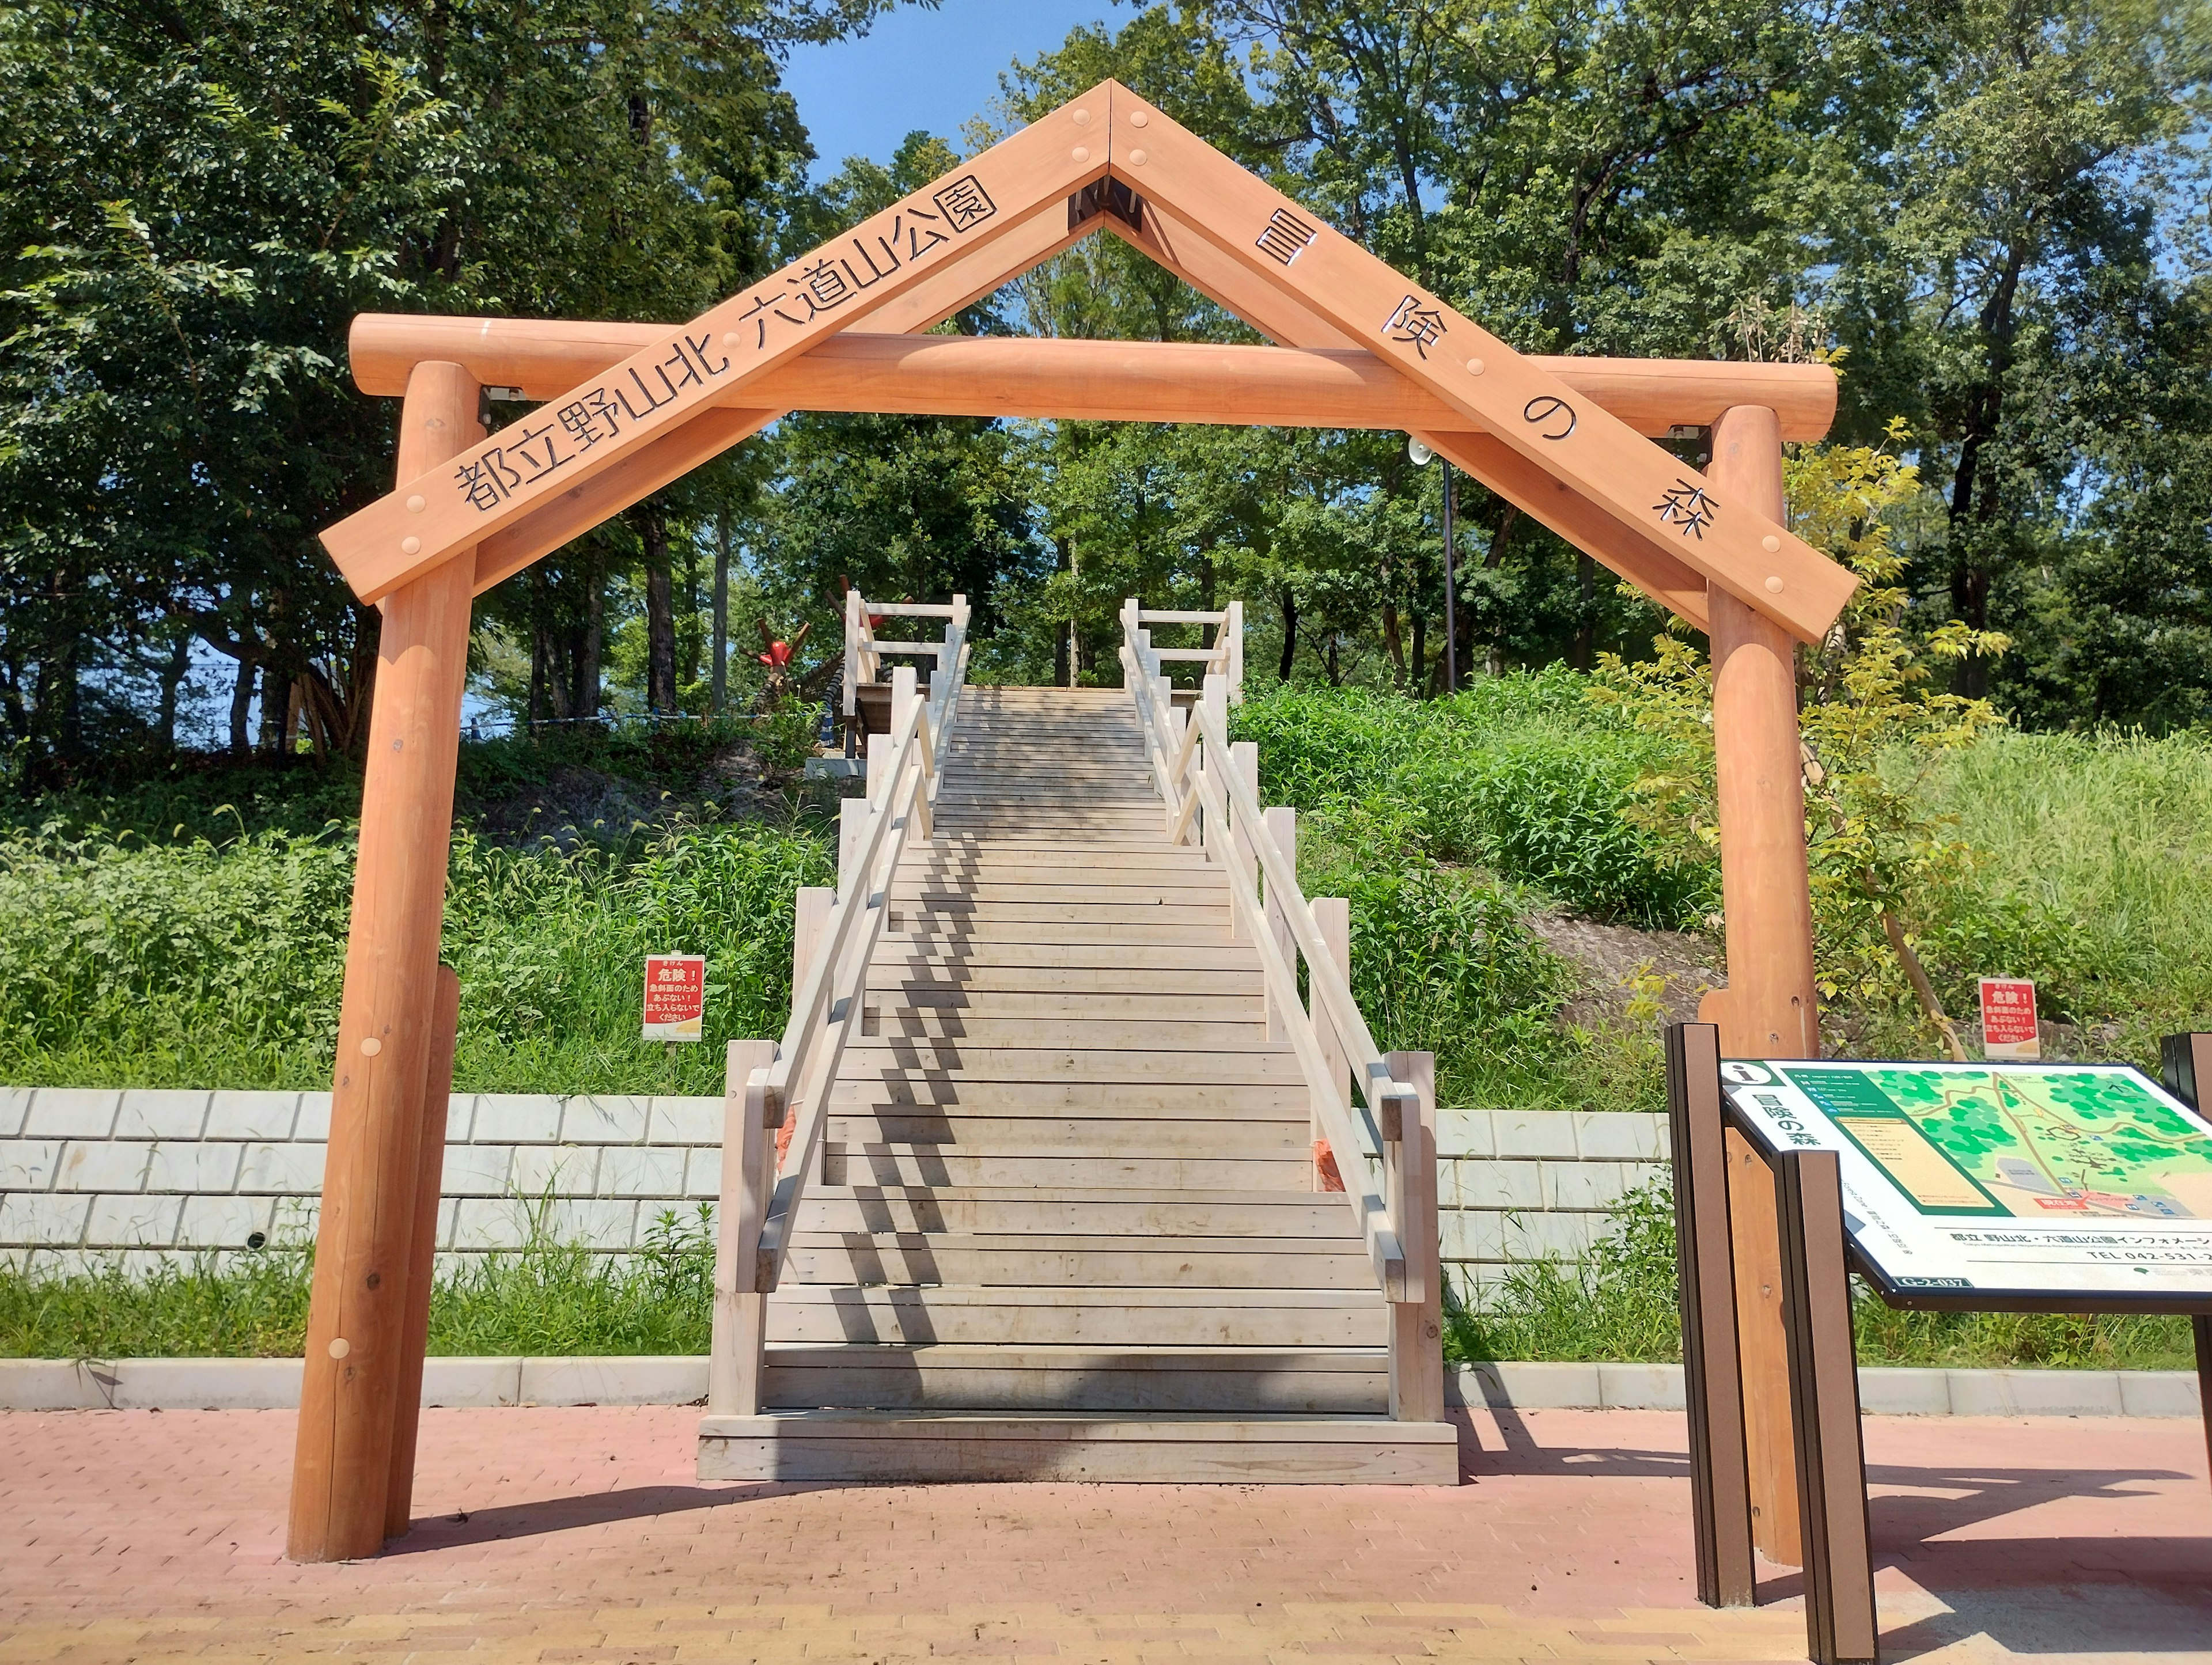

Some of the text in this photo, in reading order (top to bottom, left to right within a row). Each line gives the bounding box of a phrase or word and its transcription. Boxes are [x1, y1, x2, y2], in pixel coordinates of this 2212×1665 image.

[658, 968, 696, 982] 危険！
[649, 984, 699, 992] 急斜面のため
[653, 993, 691, 1002] あぶない！
[646, 1004, 700, 1012] 立ち入らないで
[659, 1012, 686, 1022] ください
[1752, 1094, 1821, 1146] 冒険の森
[1950, 1233, 1983, 1242] 都立
[2086, 1251, 2122, 1260] TEL
[1902, 1278, 1963, 1287] G-2-037
